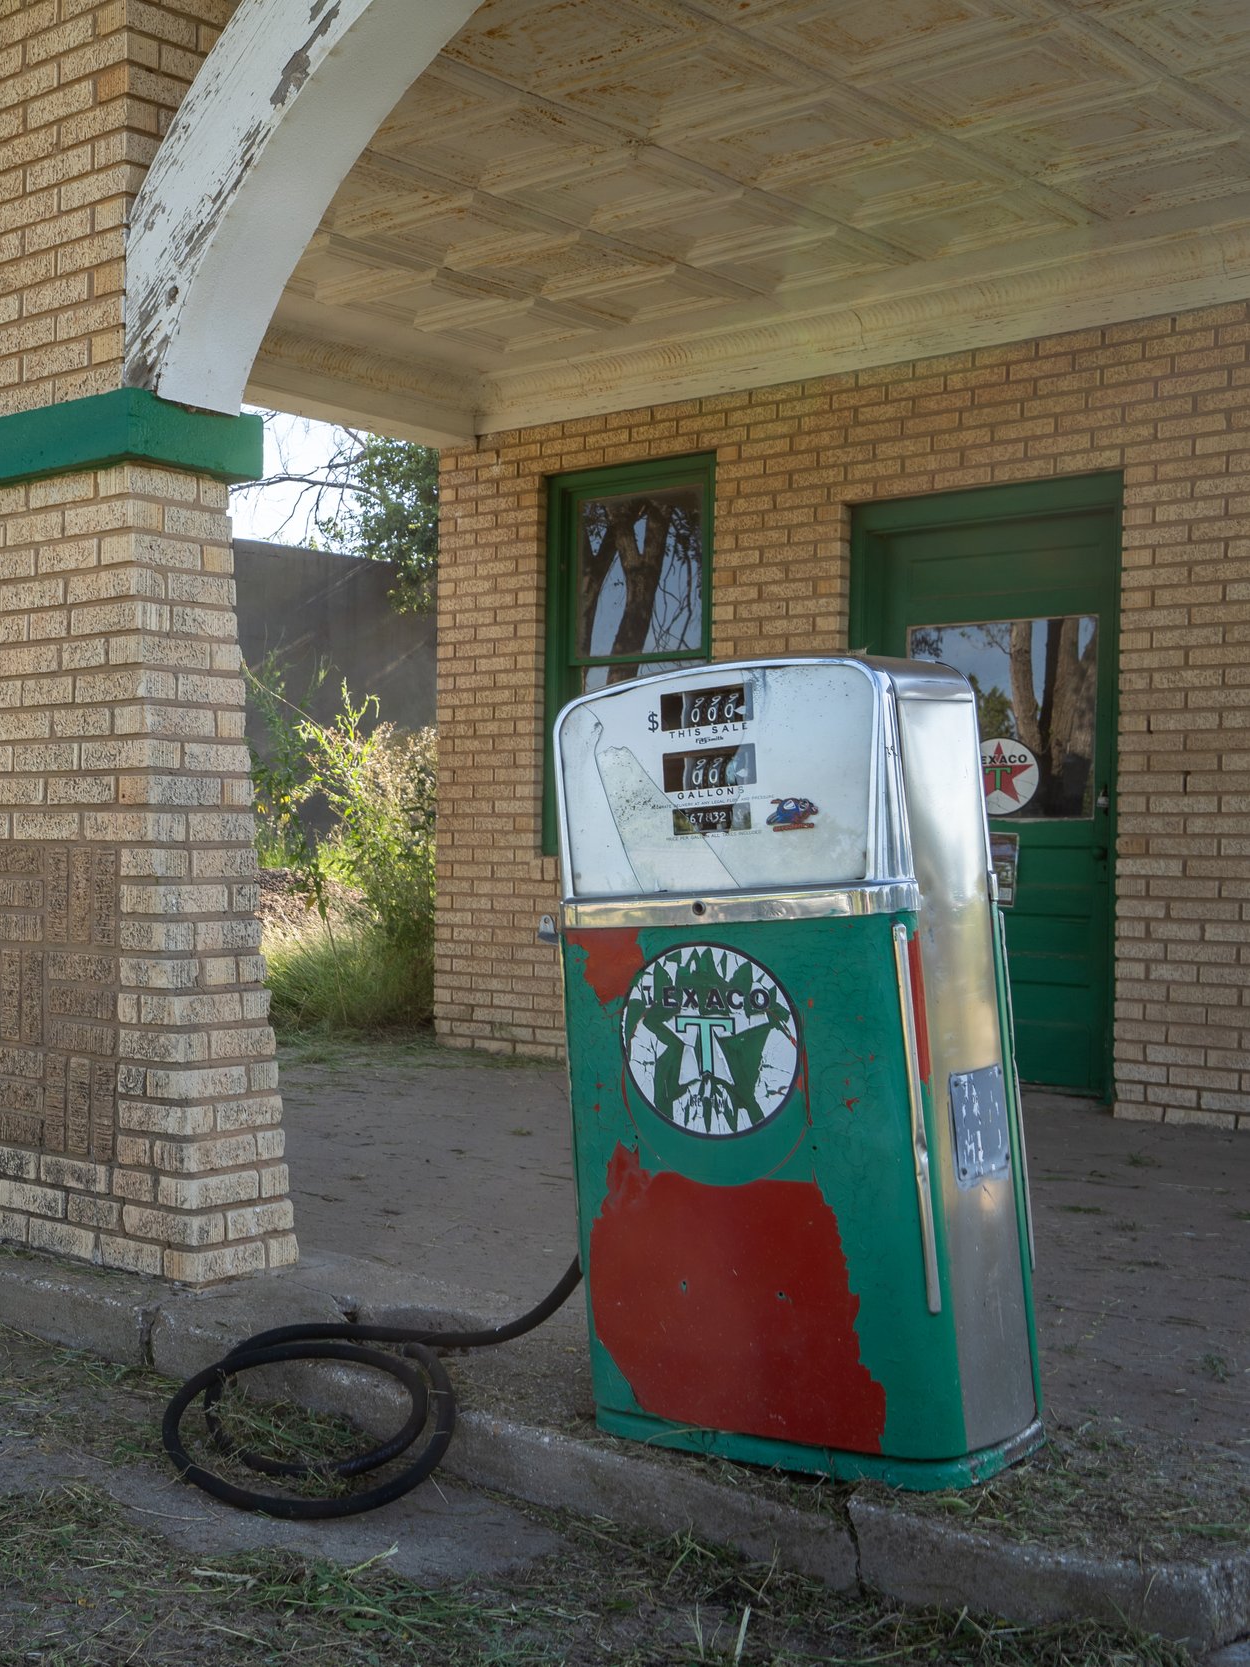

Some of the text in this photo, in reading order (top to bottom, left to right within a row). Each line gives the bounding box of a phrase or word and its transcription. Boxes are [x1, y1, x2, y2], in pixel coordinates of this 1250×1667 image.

[648, 711, 659, 732] $
[670, 722, 748, 739] THIS SALE
[981, 754, 1027, 765] EXACO
[677, 786, 745, 800] GALLONS
[642, 985, 770, 1010] TEXACO
[675, 1015, 735, 1076] T
